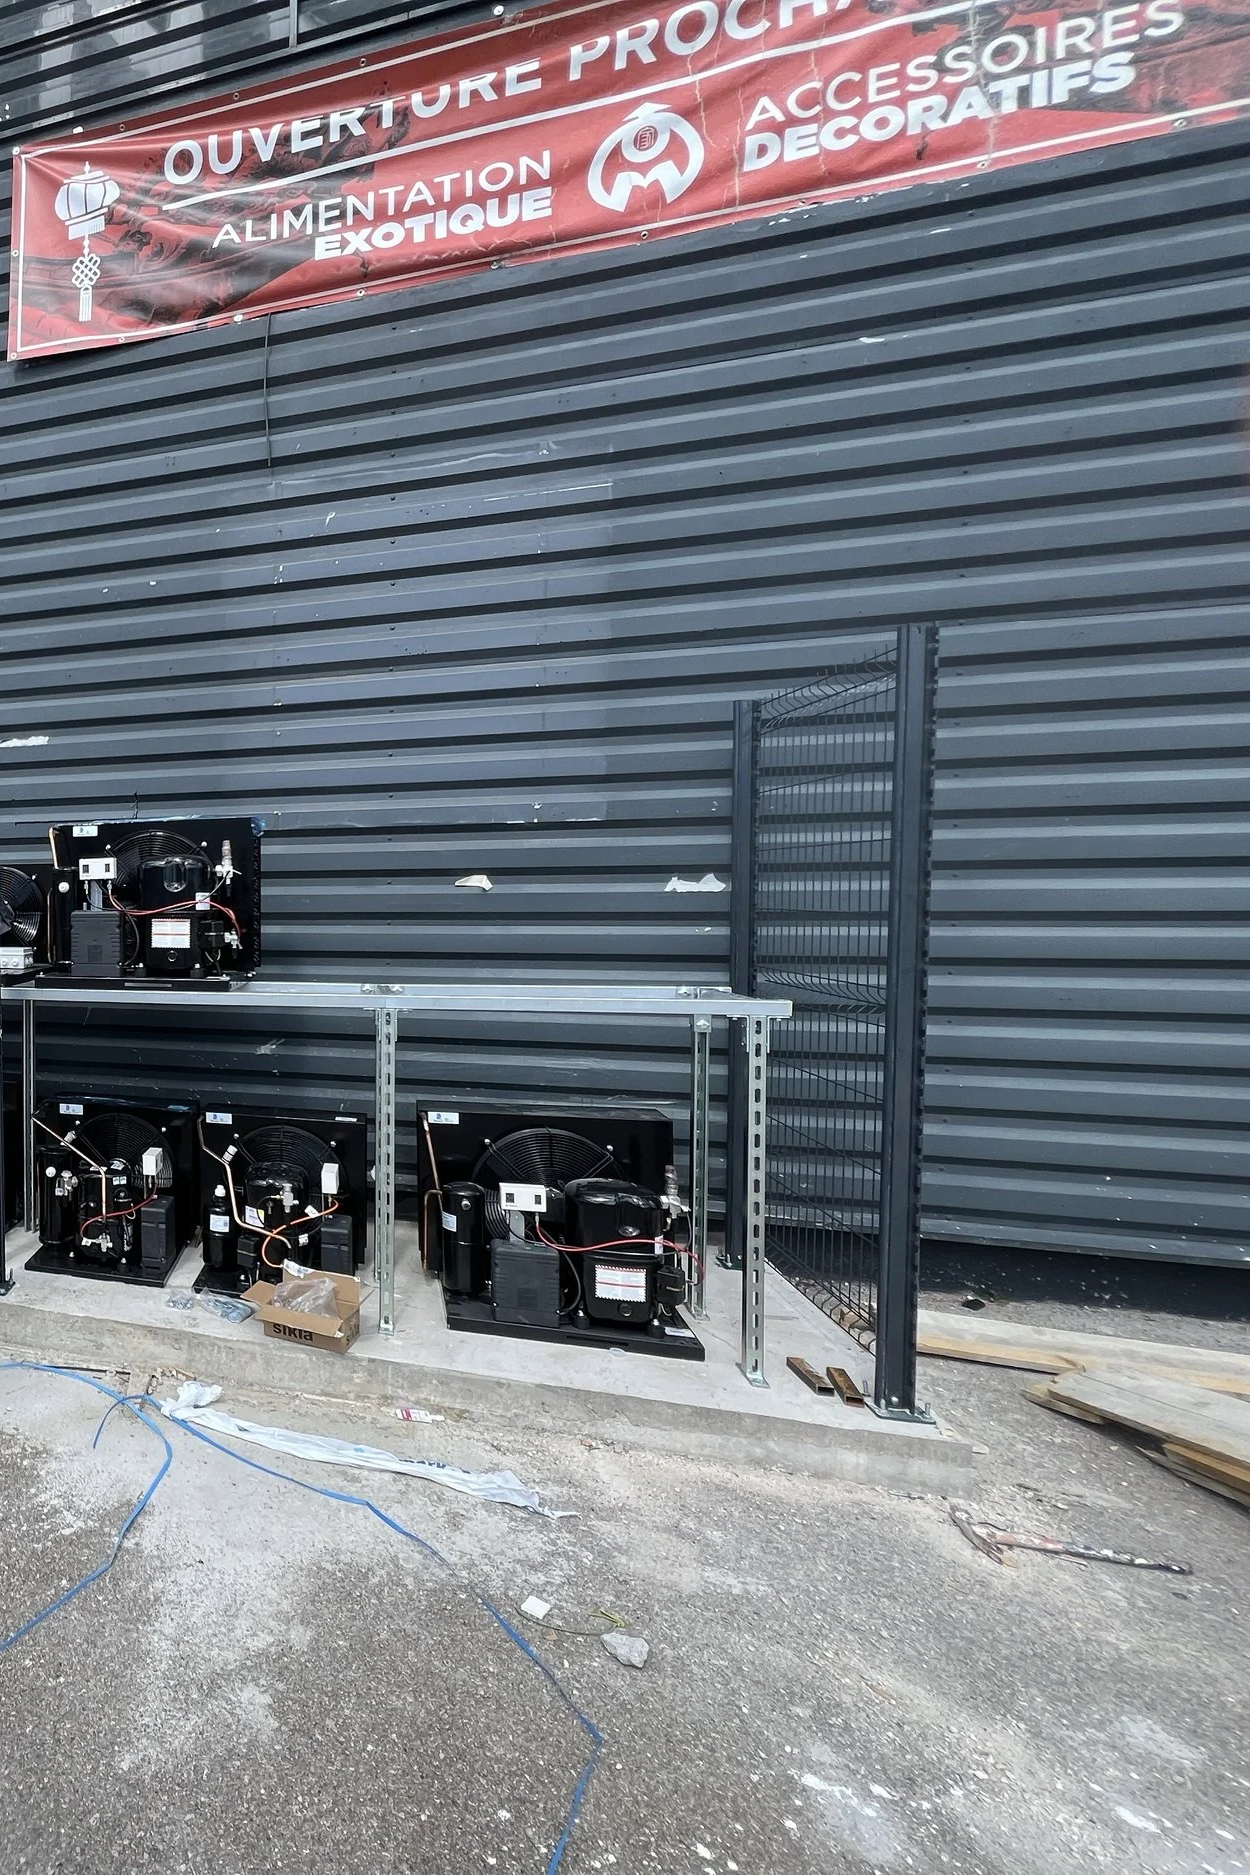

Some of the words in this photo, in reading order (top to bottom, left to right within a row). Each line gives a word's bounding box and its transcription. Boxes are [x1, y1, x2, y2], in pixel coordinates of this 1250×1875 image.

[163, 58, 542, 185] OUVERTURE
[568, 0, 851, 81] PROCH
[743, 51, 1136, 172] DECORATIFS
[745, 0, 1185, 131] ACCESSOIRES
[212, 150, 551, 248] ALIMENTATION
[314, 186, 552, 261] EXOTIQUE
